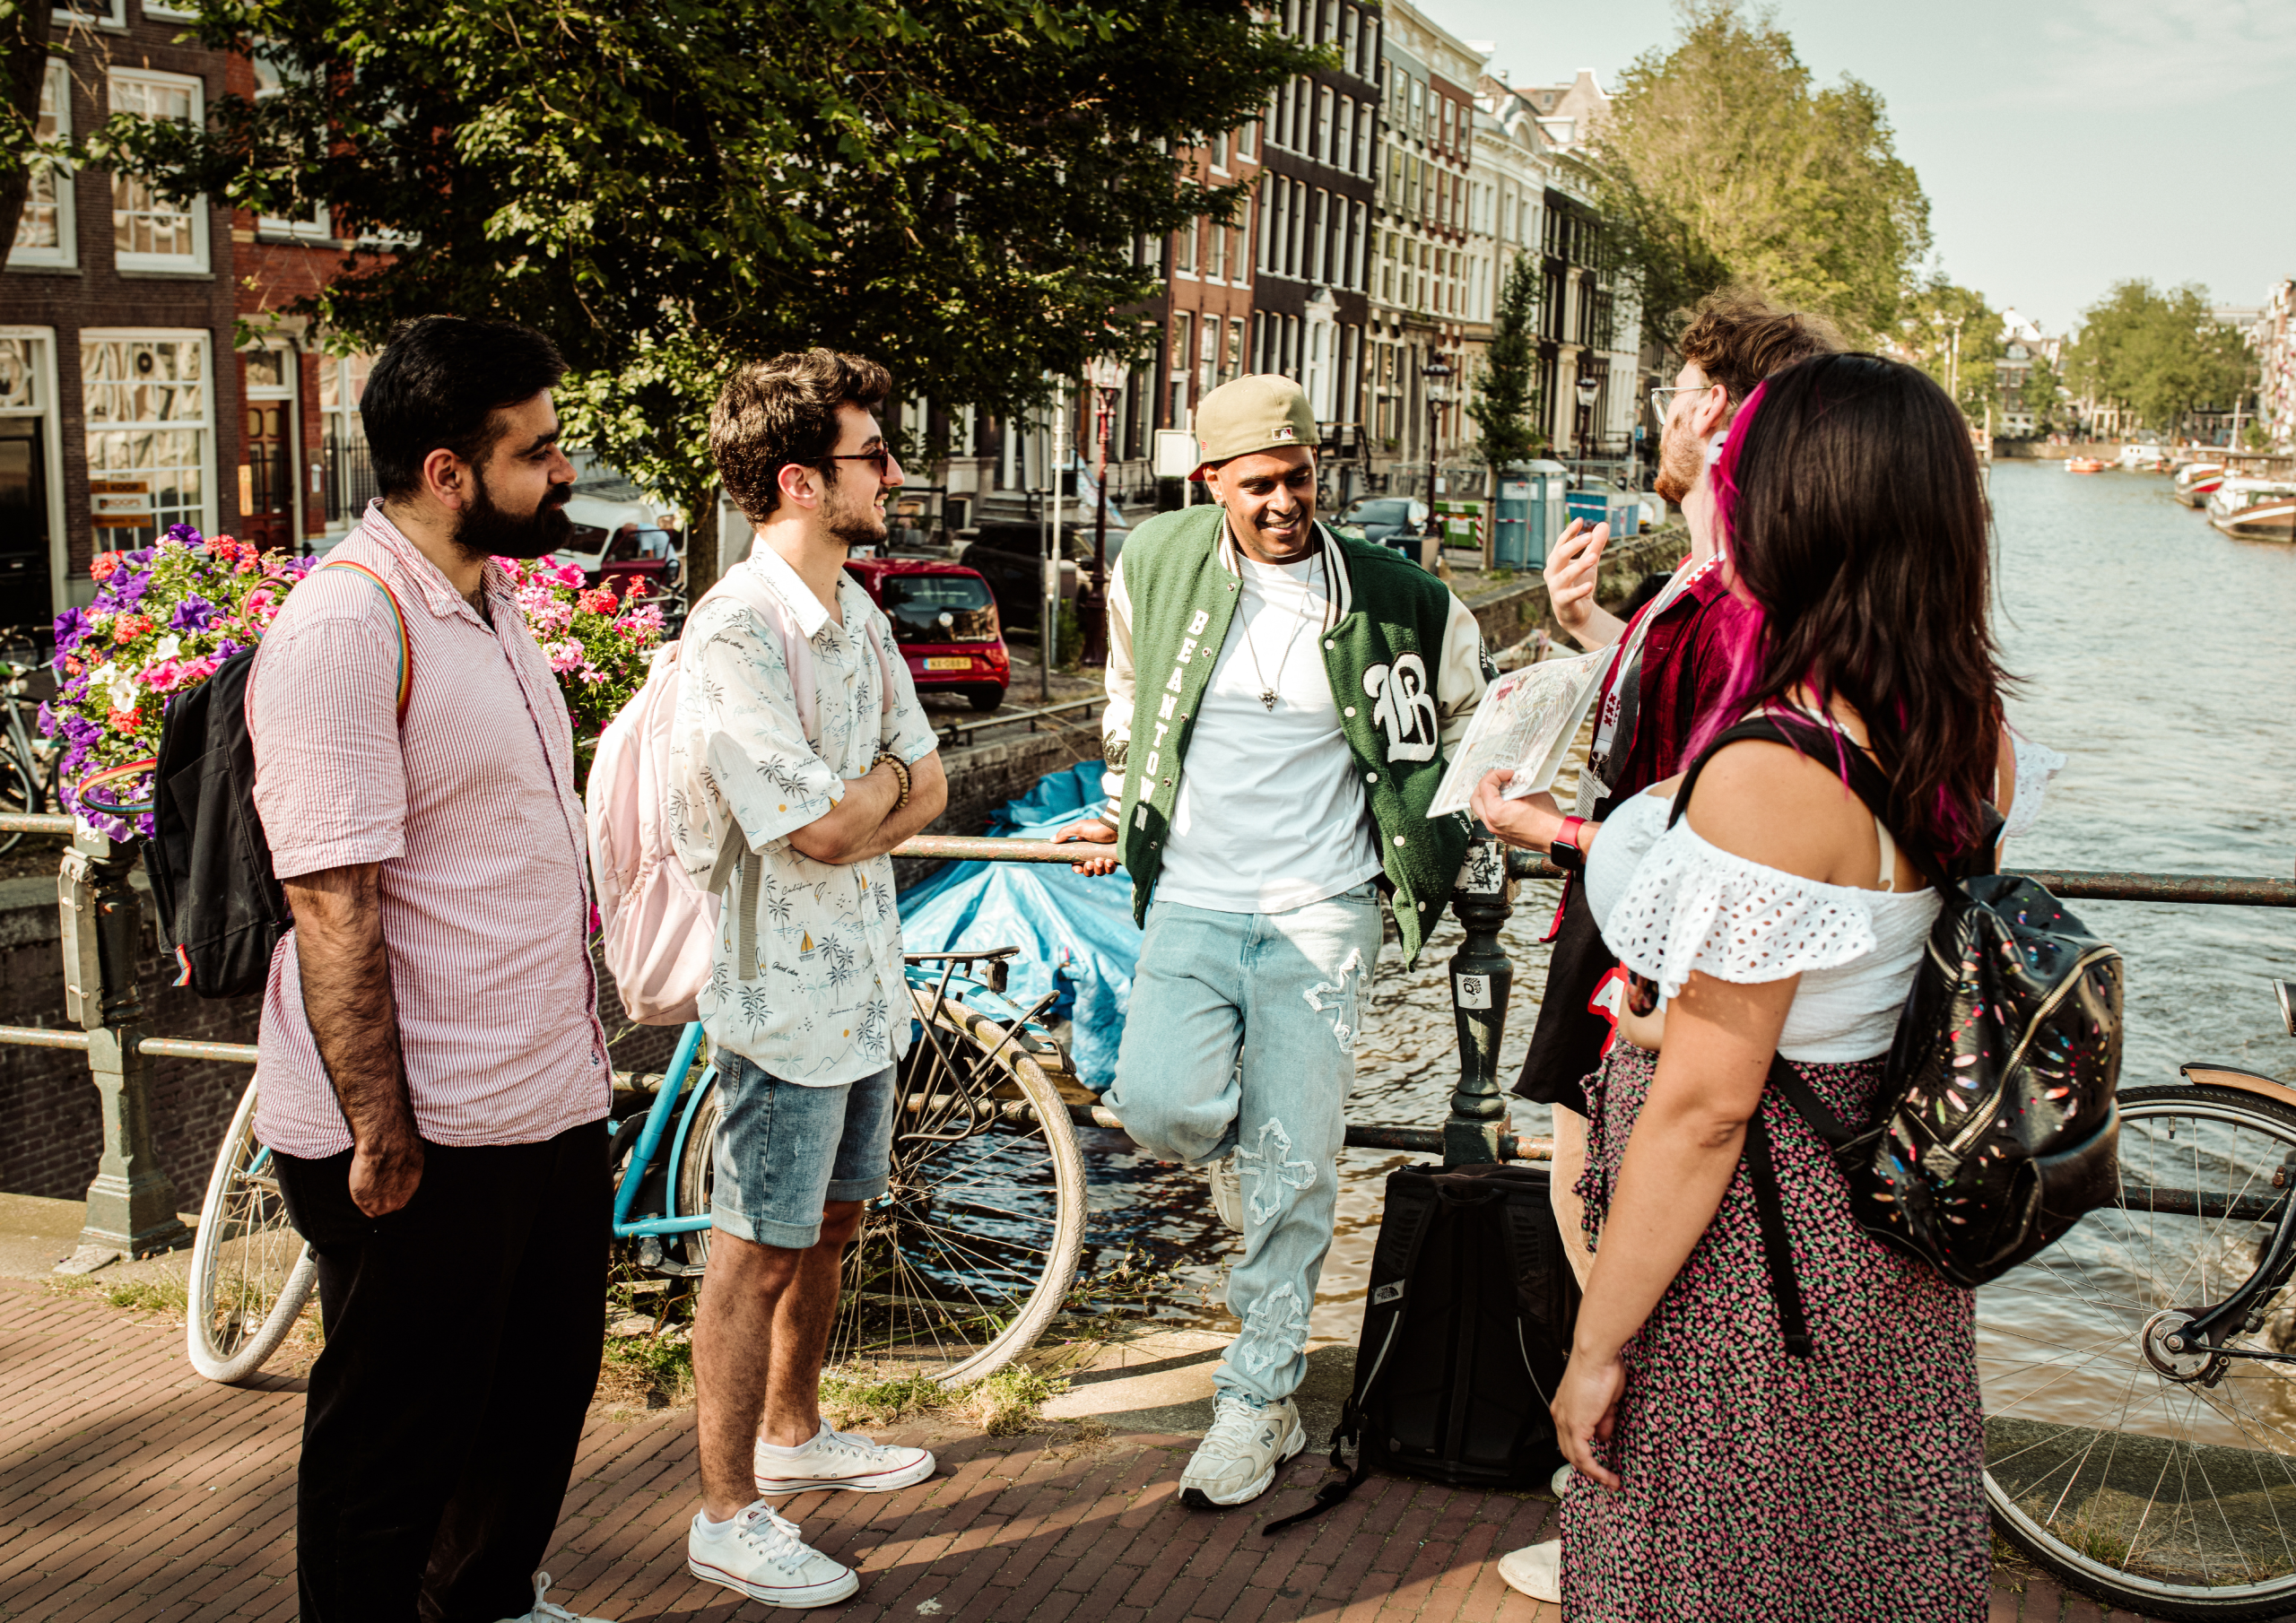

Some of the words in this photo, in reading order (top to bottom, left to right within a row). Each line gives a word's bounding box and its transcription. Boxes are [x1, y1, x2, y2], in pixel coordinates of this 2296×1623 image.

[110, 482, 139, 491] KOOP
[710, 632, 731, 644] Good
[1134, 609, 1210, 832] BEANTOWN
[771, 960, 789, 972] Good
